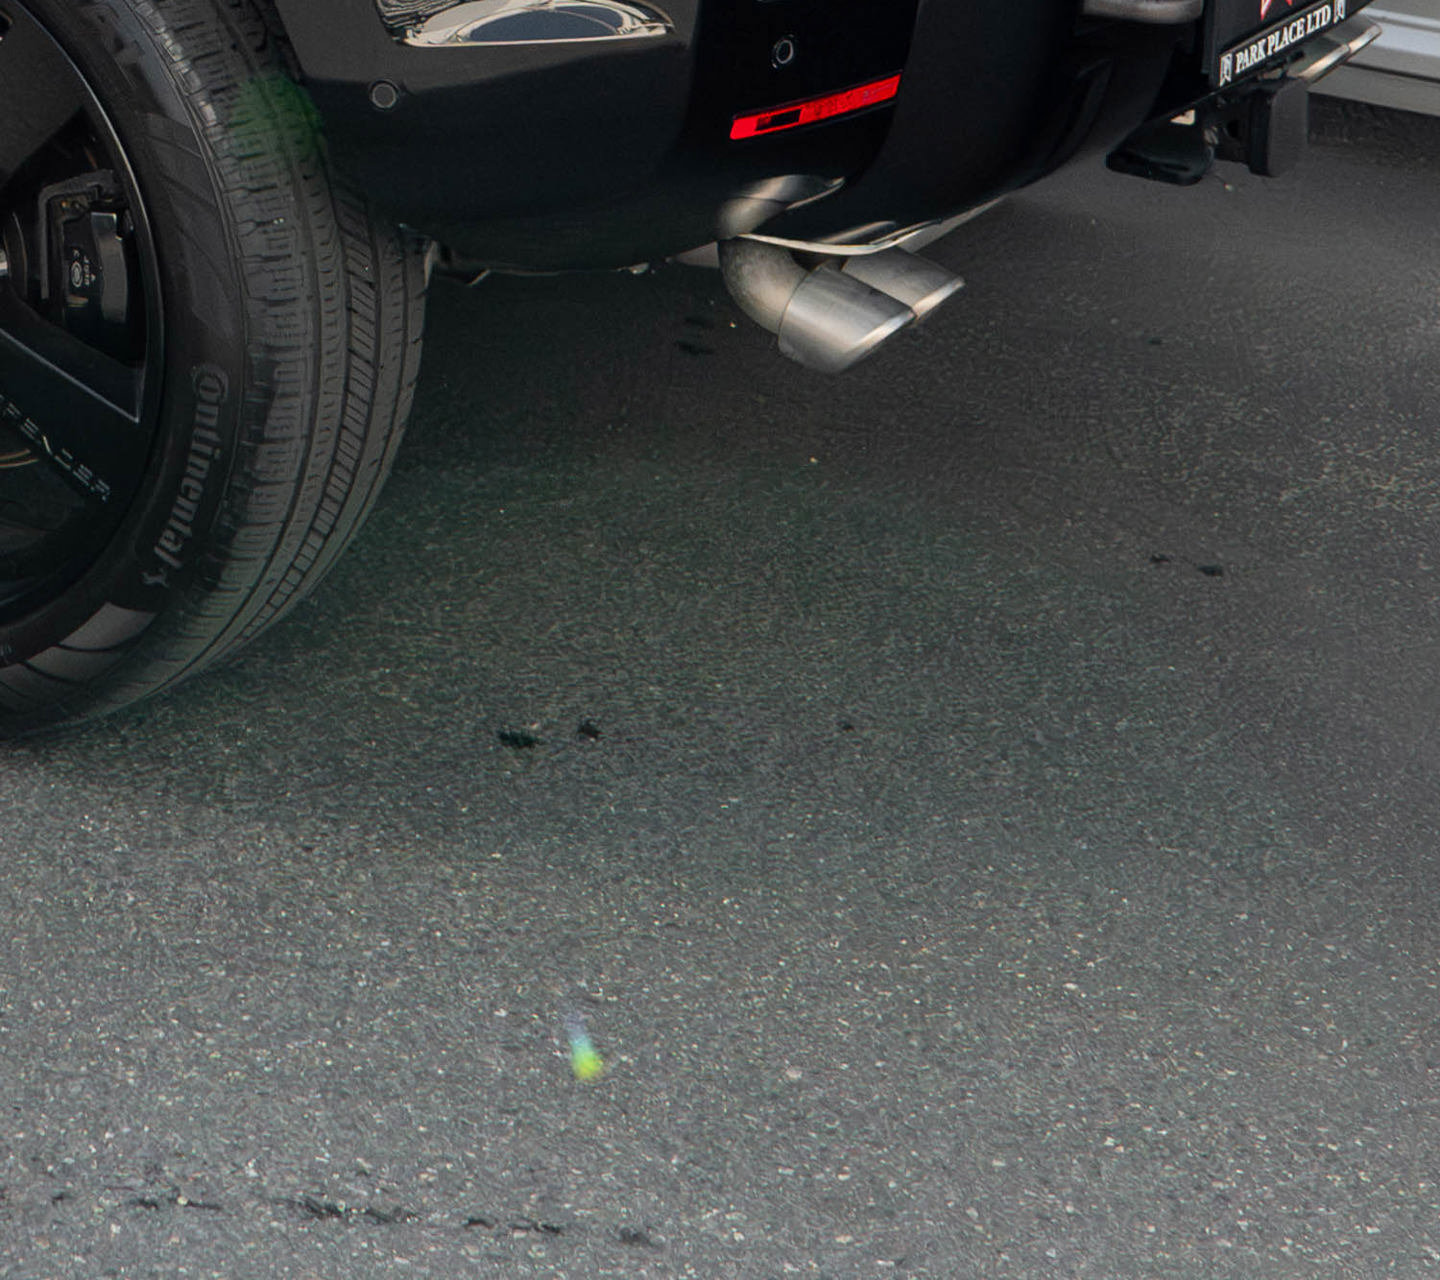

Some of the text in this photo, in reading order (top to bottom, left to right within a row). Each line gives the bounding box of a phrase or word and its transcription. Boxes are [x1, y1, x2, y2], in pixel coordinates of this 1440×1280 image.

[1234, 37, 1267, 75] PARK
[1266, 16, 1306, 58] PLACE
[1305, 3, 1332, 36] LTD
[152, 361, 230, 570] Continental
